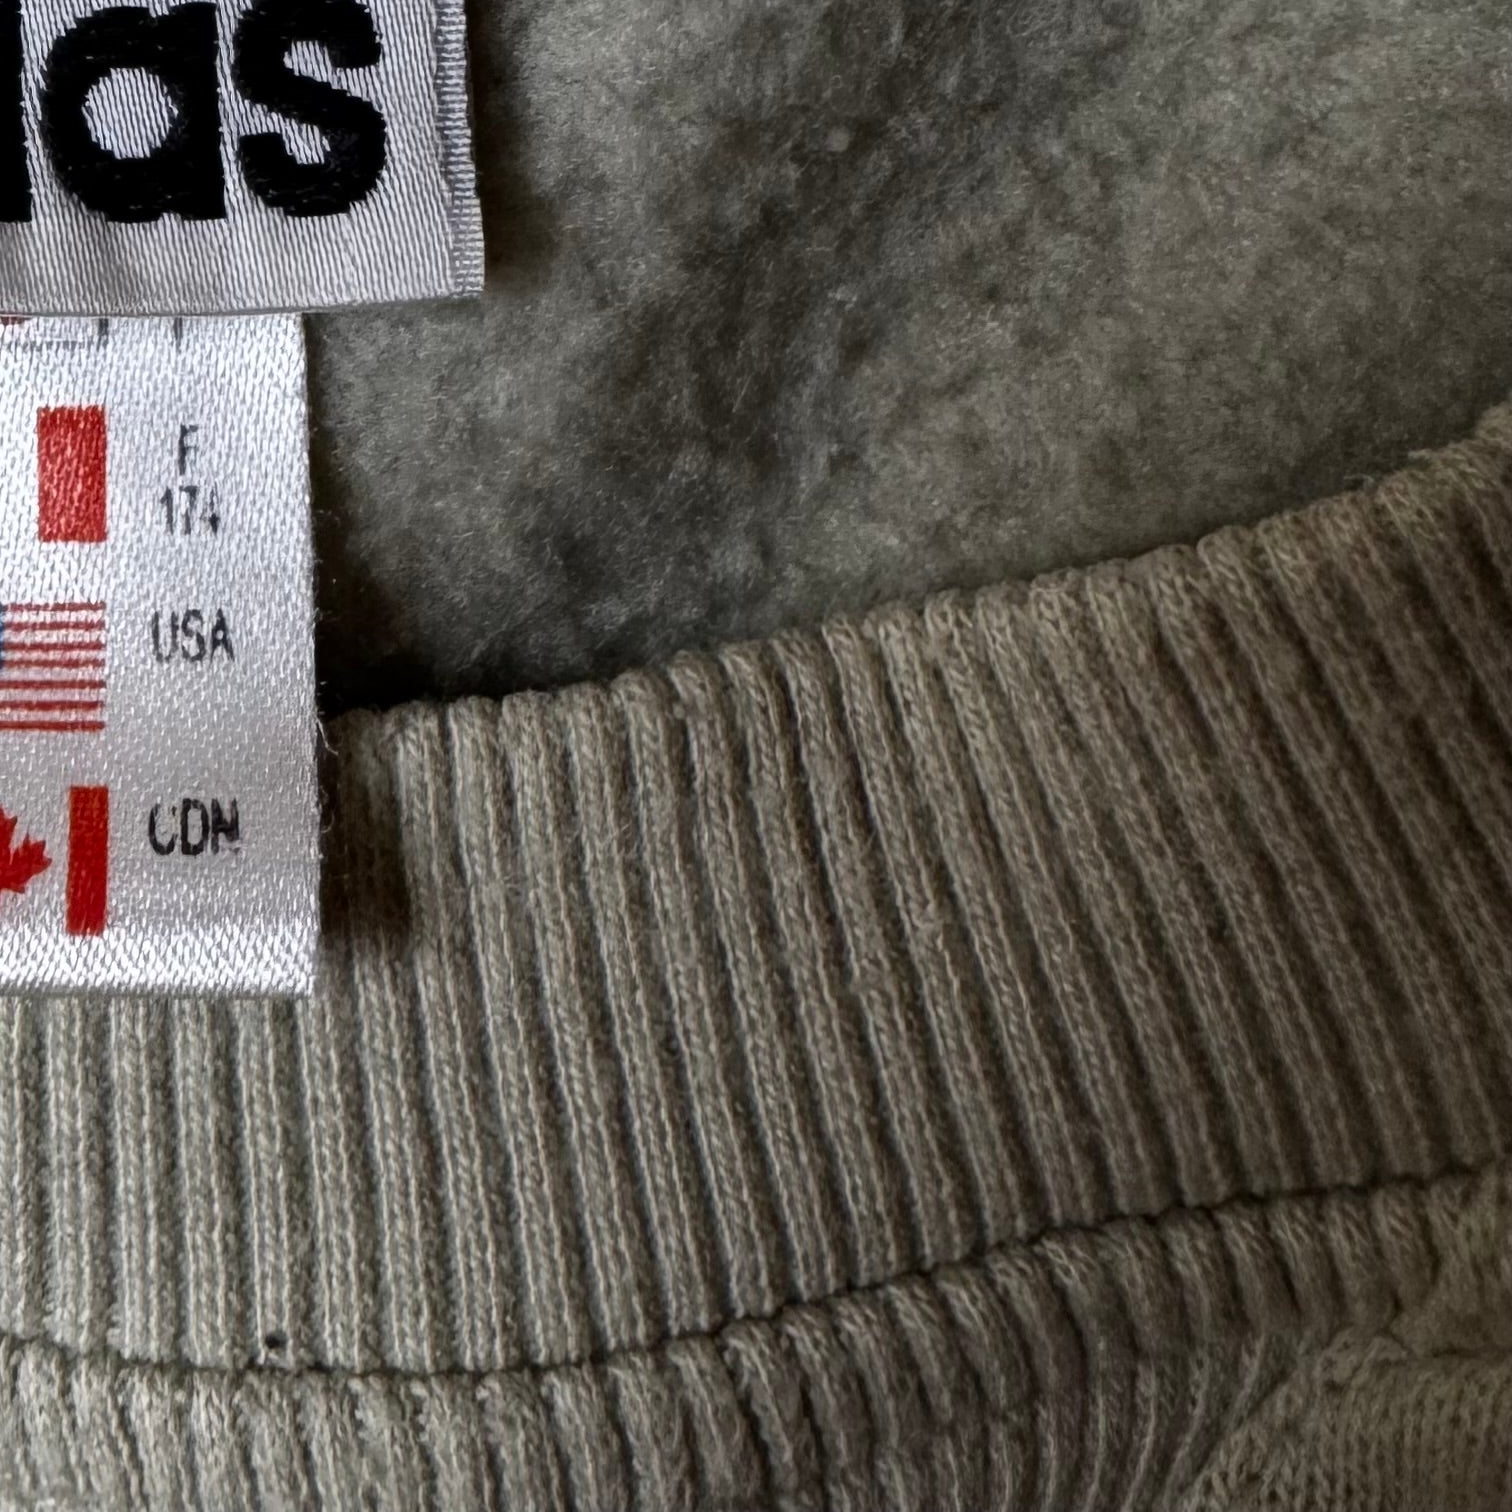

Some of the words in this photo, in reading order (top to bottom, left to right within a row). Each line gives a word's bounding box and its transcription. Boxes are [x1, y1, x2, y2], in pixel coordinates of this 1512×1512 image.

[178, 424, 199, 476] F
[159, 484, 220, 536] 174
[150, 607, 235, 662] USA
[148, 796, 241, 857] CDN
